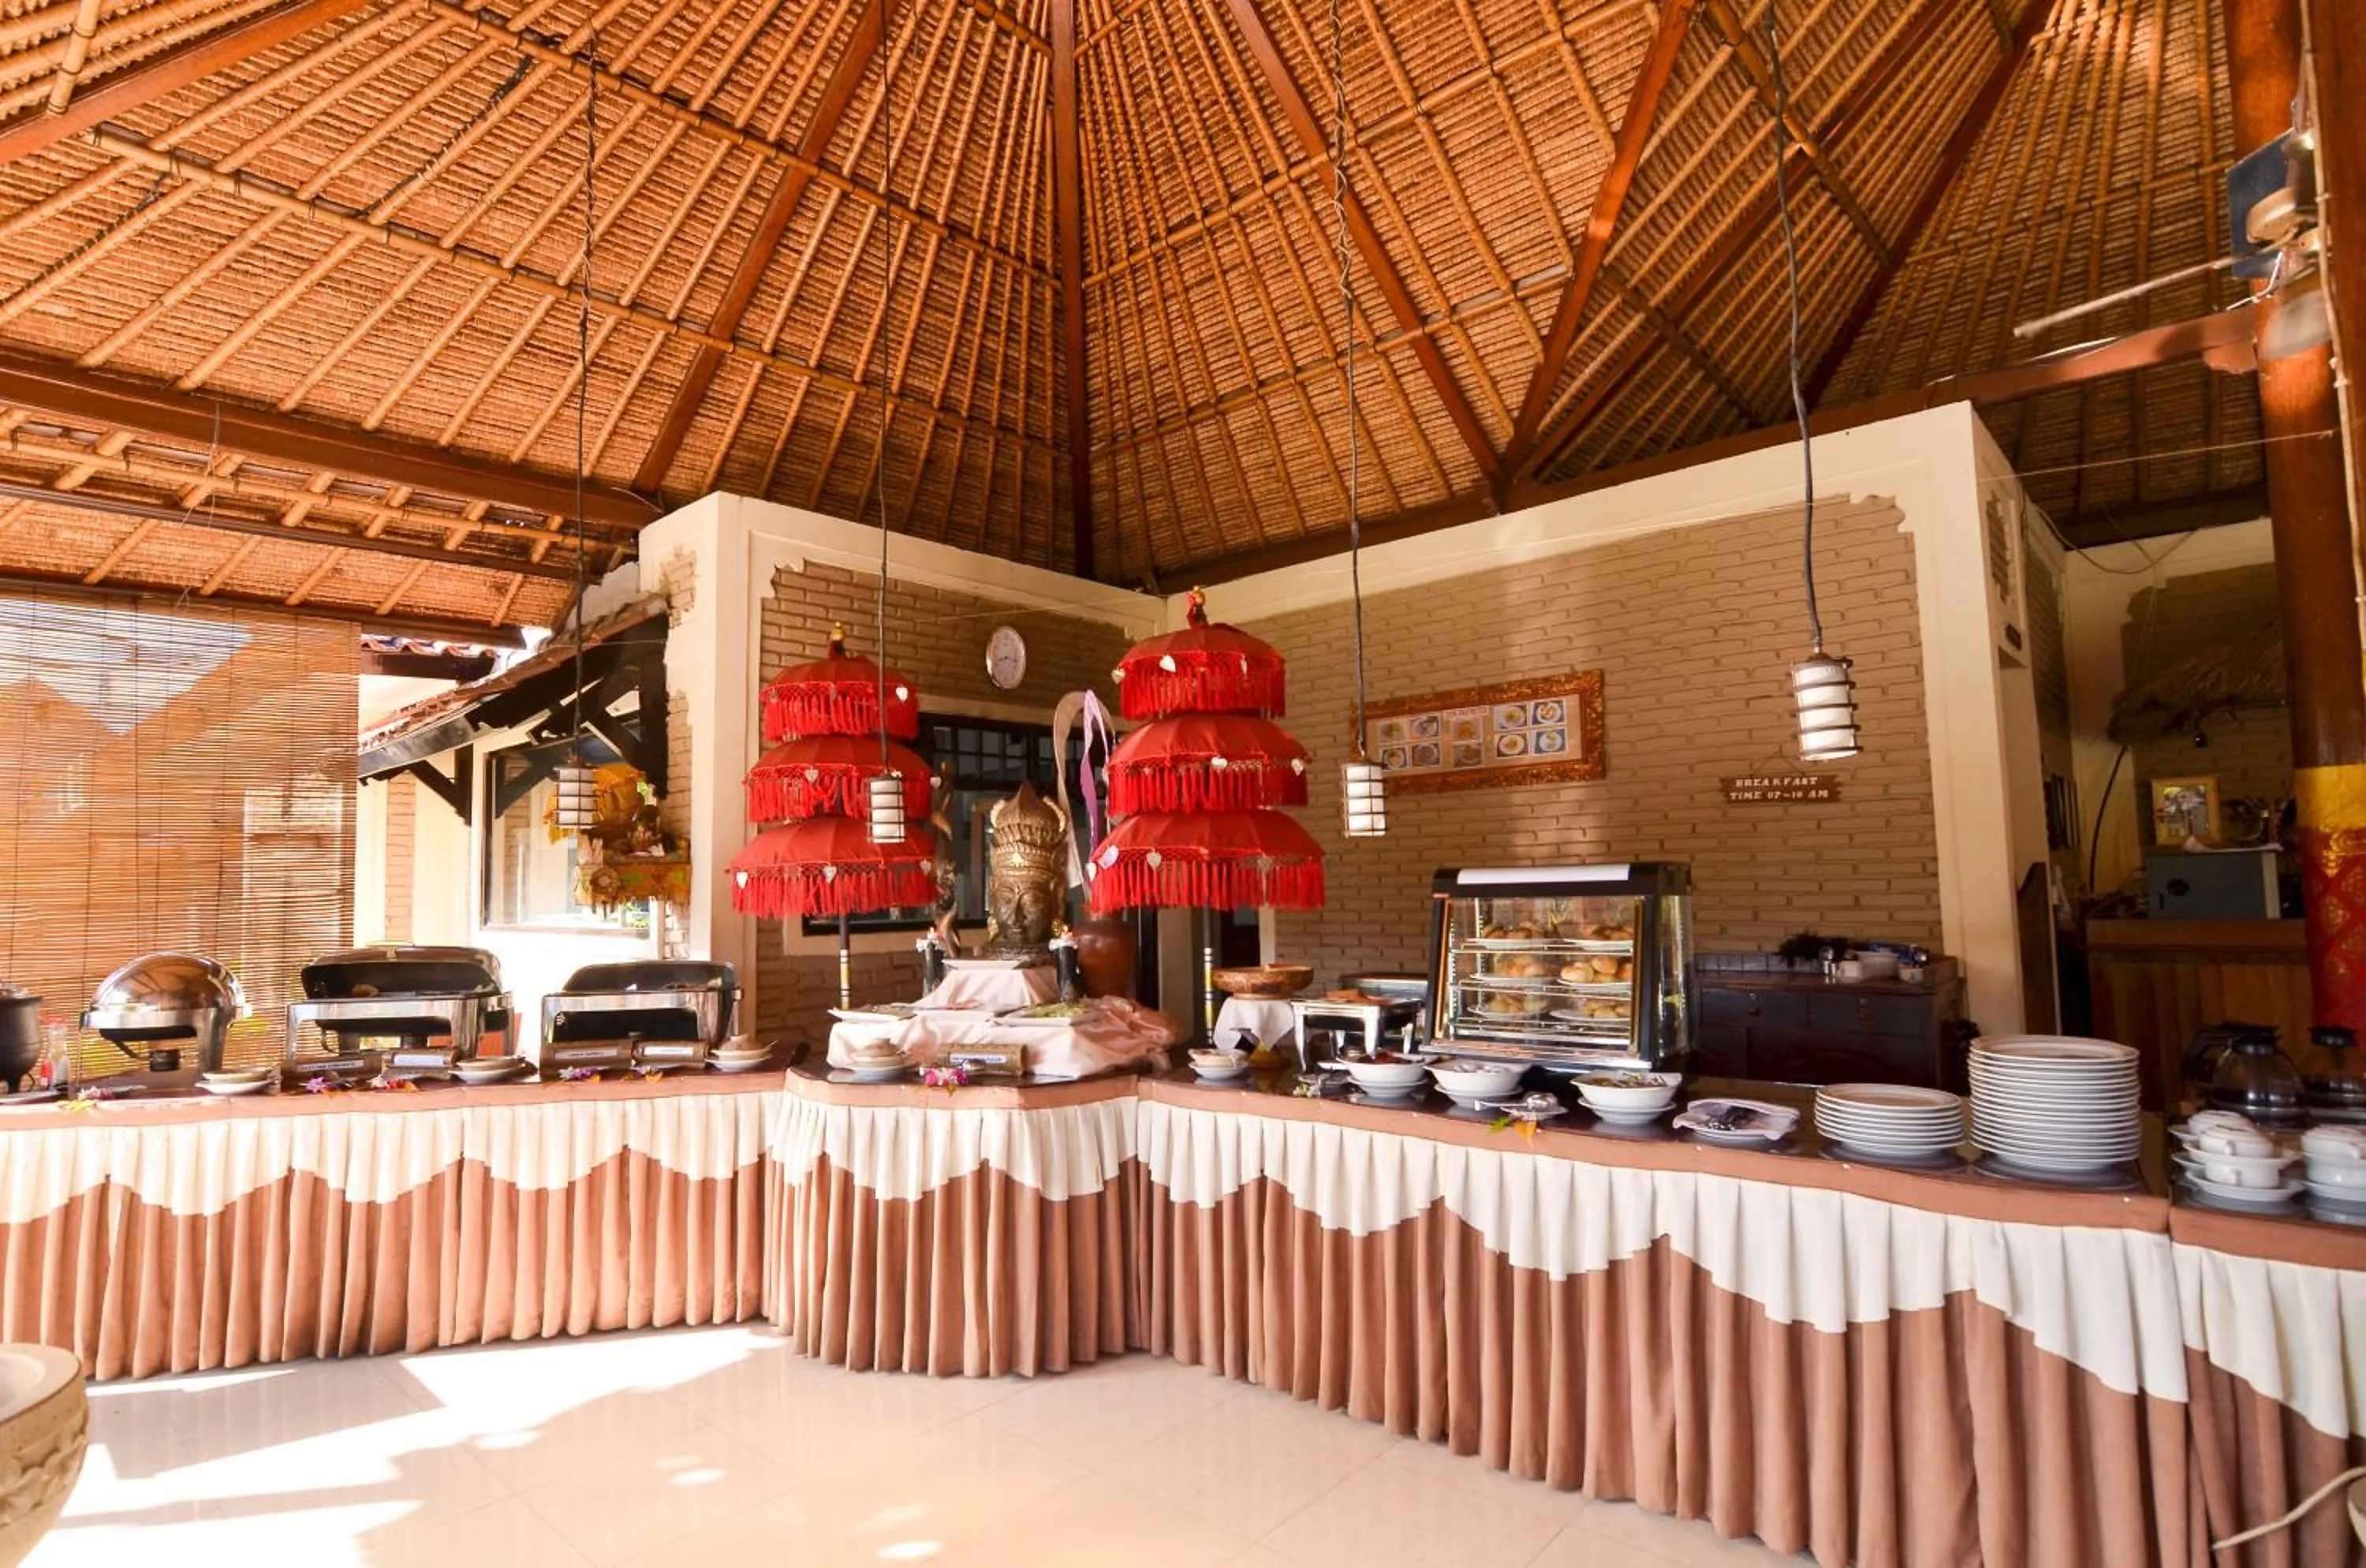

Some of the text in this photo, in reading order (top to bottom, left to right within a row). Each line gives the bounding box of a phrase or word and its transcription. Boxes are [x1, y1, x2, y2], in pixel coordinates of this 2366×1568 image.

[1736, 777, 1818, 787] BREAKFAST
[1730, 791, 1763, 800] TIME
[1808, 790, 1829, 798] AM
